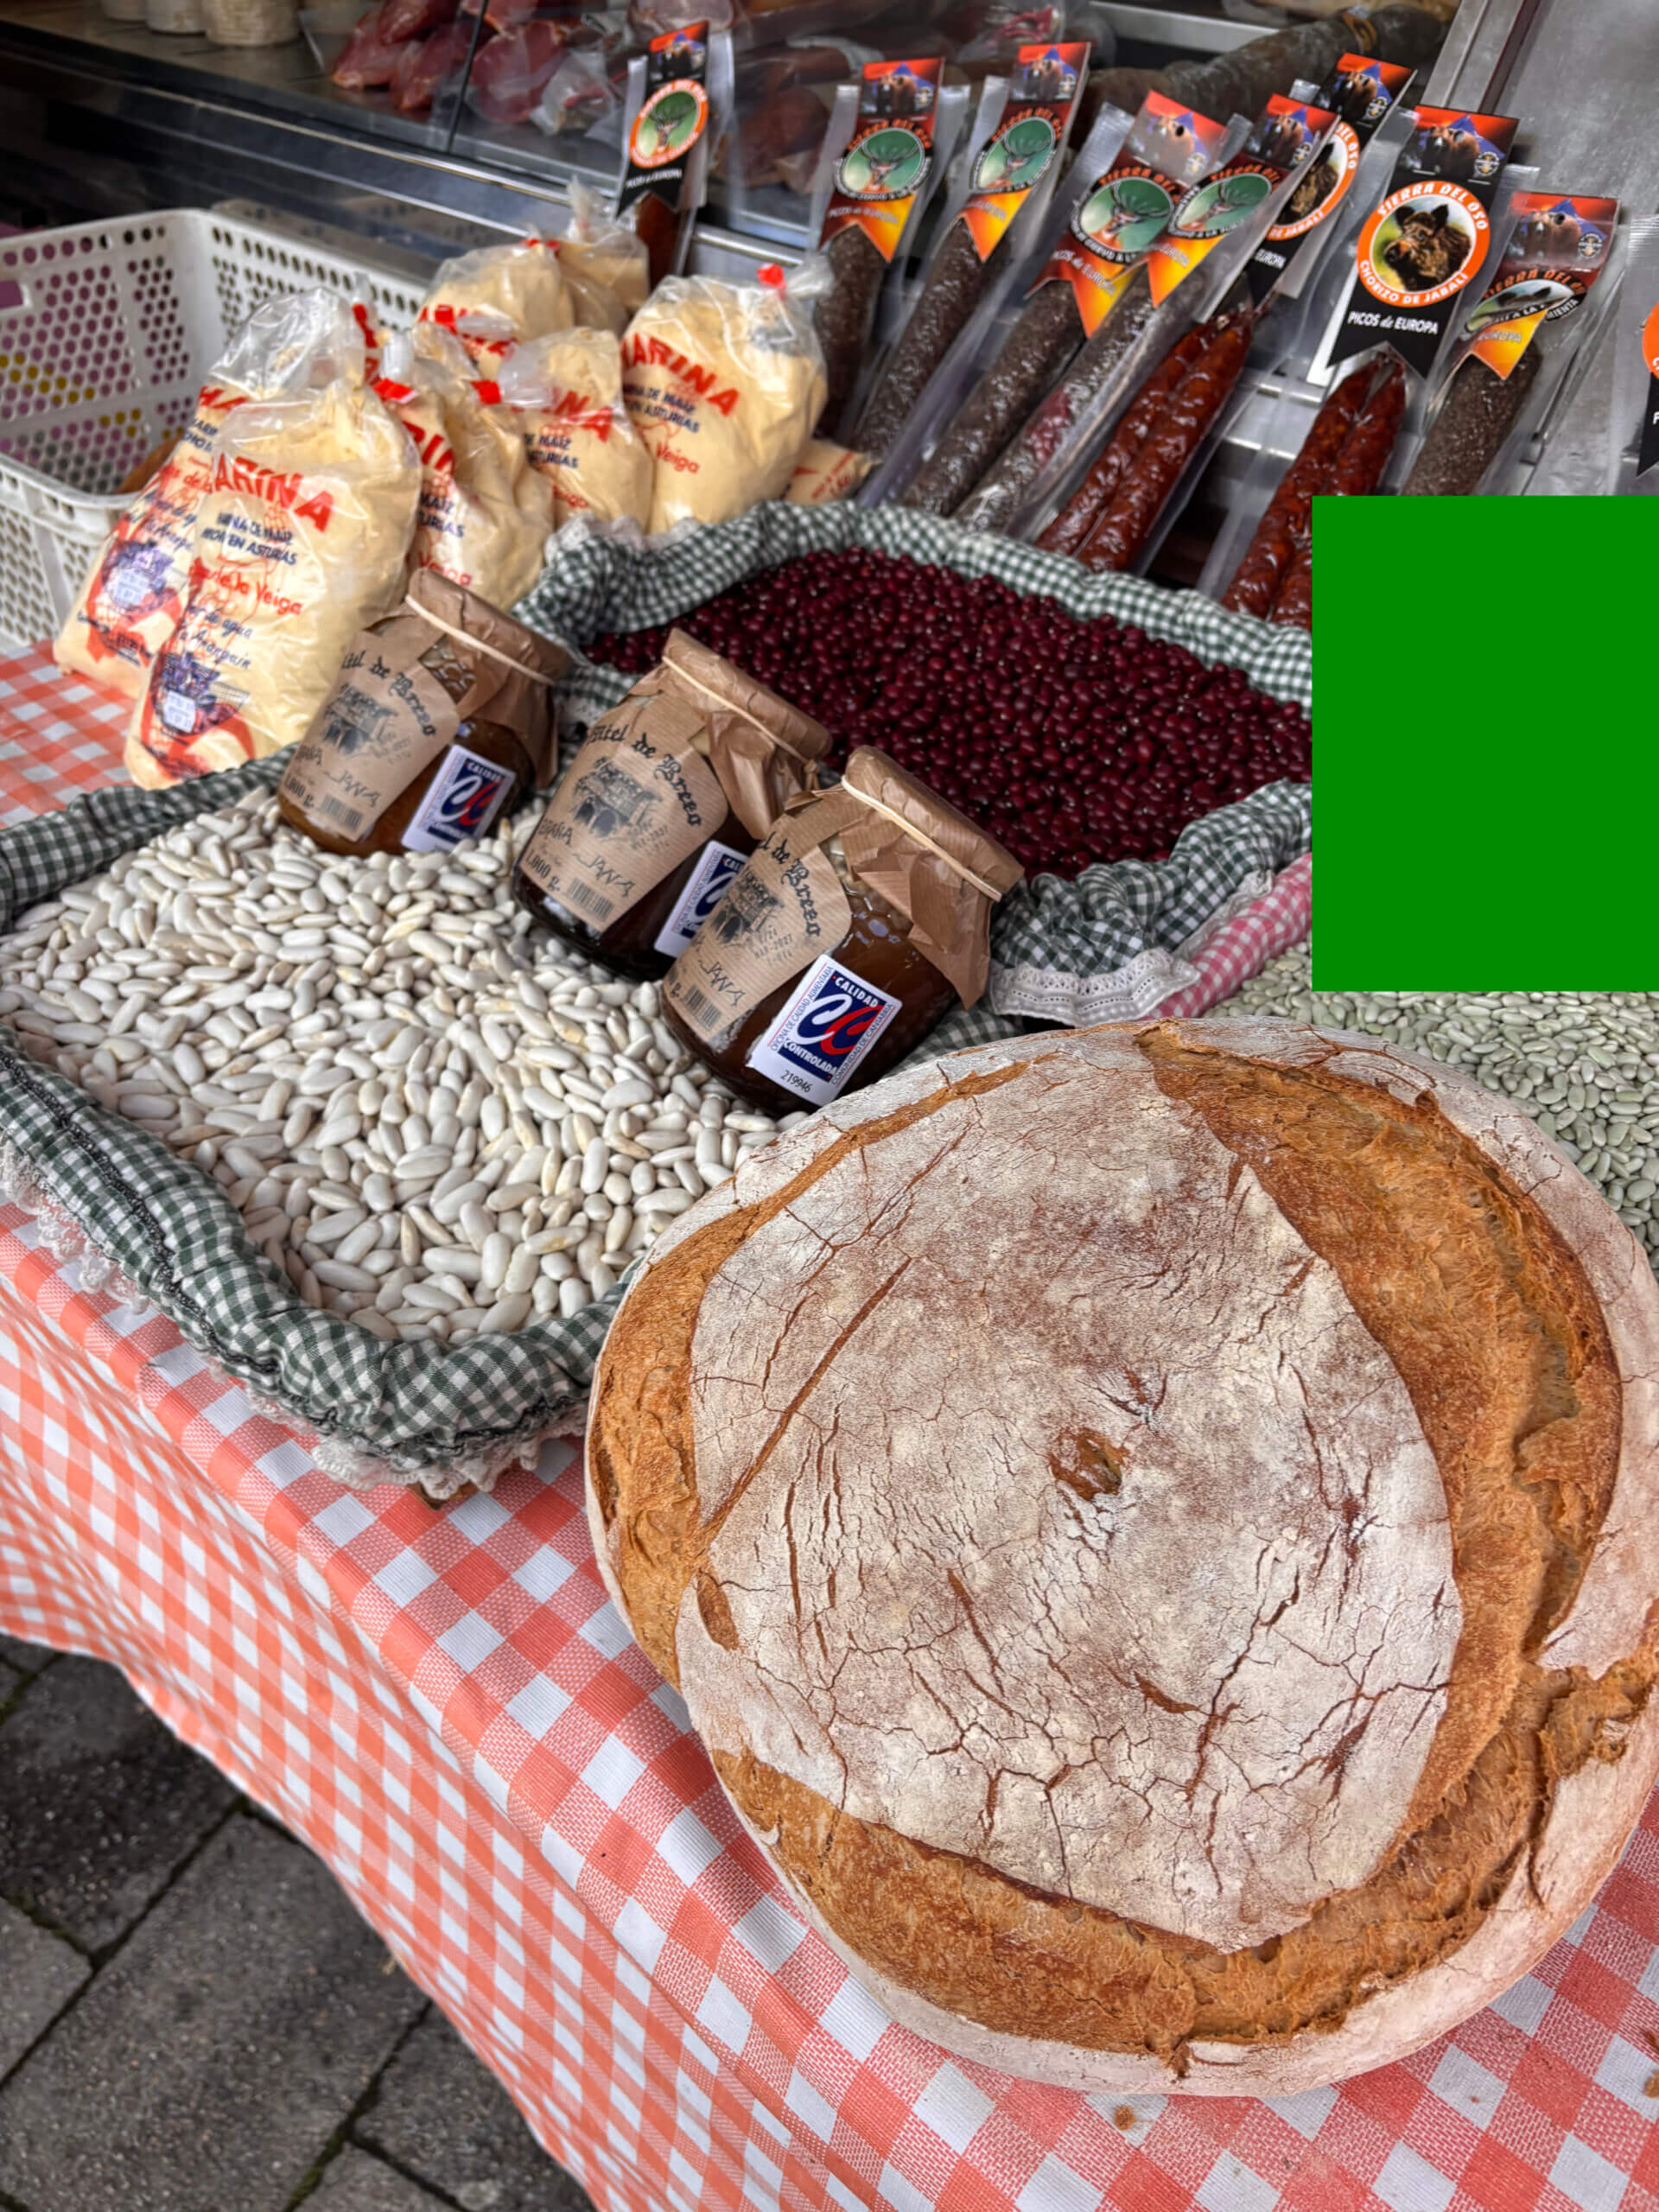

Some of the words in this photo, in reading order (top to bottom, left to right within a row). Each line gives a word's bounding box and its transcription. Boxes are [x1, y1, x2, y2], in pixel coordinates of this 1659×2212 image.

[1376, 182, 1434, 215] SIERRA
[1439, 184, 1465, 203] DEL
[1467, 202, 1489, 231] OSO
[1359, 259, 1400, 303] CHORIZO
[1402, 295, 1421, 305] DE
[1348, 311, 1381, 326] PICOS
[1394, 316, 1439, 336] EUROPA
[215, 452, 334, 534] ARINA
[256, 580, 304, 617] Veiga
[631, 732, 658, 760] de
[771, 837, 791, 865] de
[770, 1031, 790, 1052] OFICINA
[791, 997, 811, 1023] CALIDAD
[807, 965, 834, 1002] ALIMENTARIA
[835, 976, 880, 1008] CALIDAD
[865, 1002, 894, 1039] CANTABRIA
[783, 1037, 840, 1076] CONTROLADA
[780, 1069, 814, 1094] 219946
